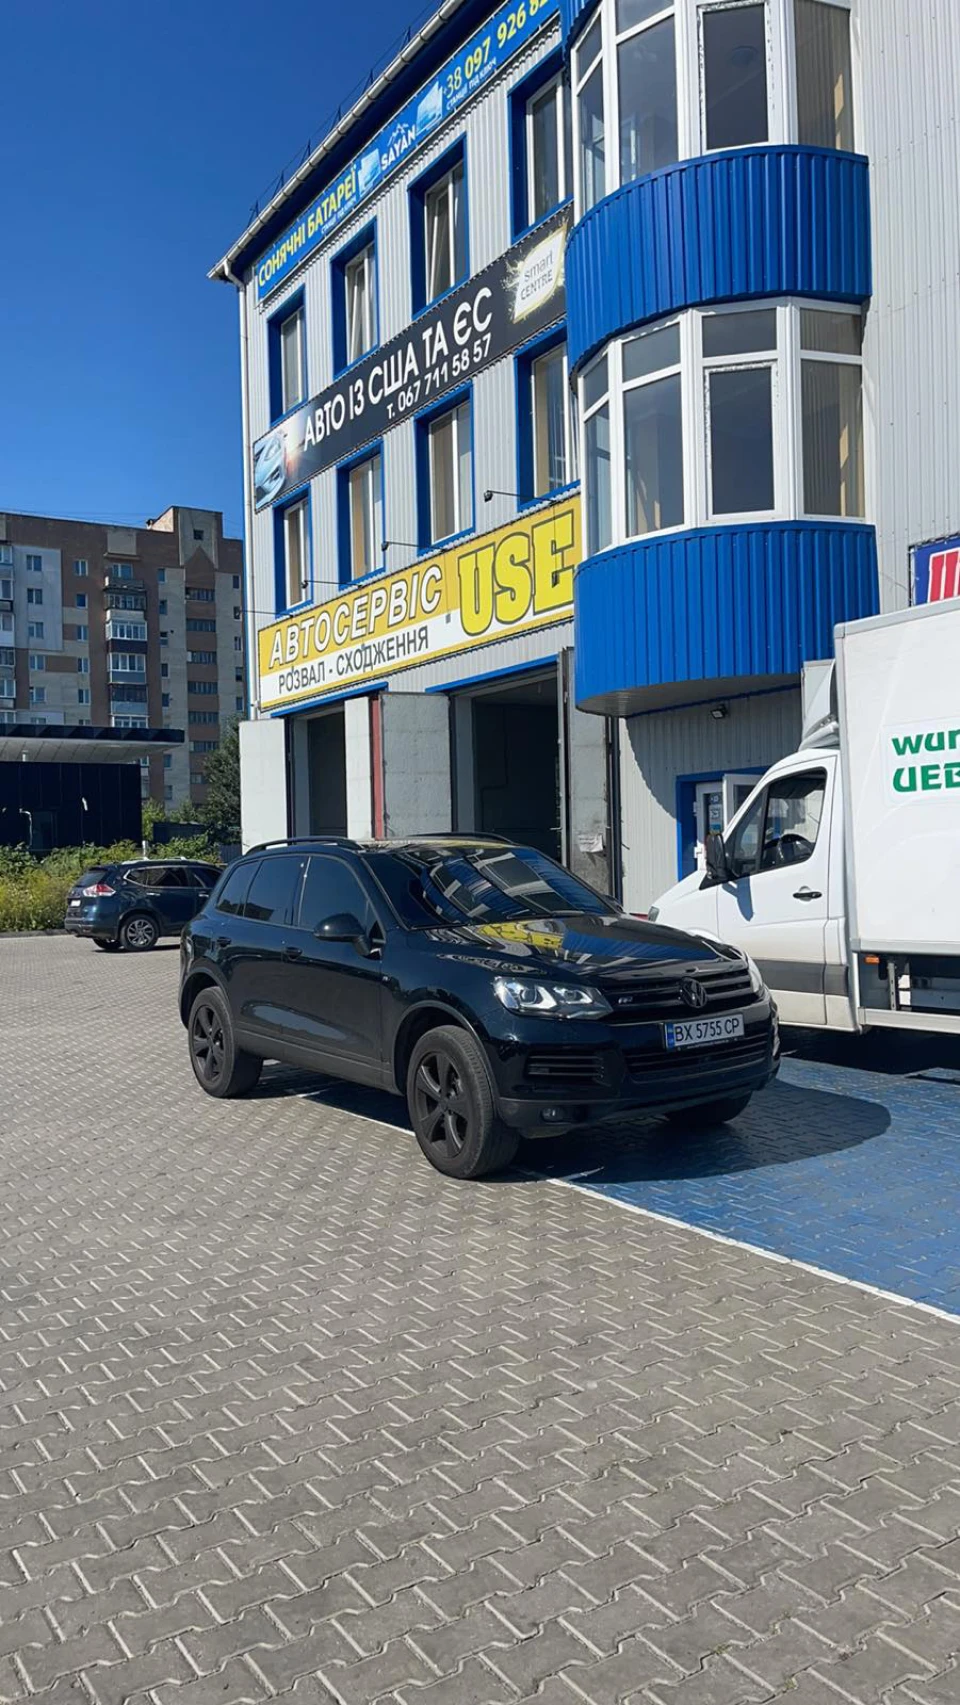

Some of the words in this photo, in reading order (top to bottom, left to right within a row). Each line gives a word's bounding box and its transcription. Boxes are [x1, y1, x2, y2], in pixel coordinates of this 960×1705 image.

[465, 36, 491, 79] 097
[497, 2, 526, 48] 926
[381, 125, 416, 171] SAYAN
[258, 222, 305, 286] СОНЯЧНІ
[307, 164, 357, 238] БАТАРЕЇ
[521, 269, 553, 300] CENTRE
[524, 250, 553, 282] smart
[304, 394, 345, 451] АВТО
[350, 379, 365, 420] ІЗ
[368, 342, 418, 405] США
[422, 321, 448, 365] ТА
[453, 287, 492, 346] ЄС
[398, 381, 420, 412] 067
[424, 362, 448, 395] 711
[452, 348, 470, 377] 58
[473, 333, 491, 363] 57
[457, 508, 574, 636] USE
[268, 564, 443, 669] АВТОСЕРВІС
[278, 660, 326, 694] РОЗВАЛ
[336, 626, 429, 674] СХОДЖЕННЯ
[675, 1026, 693, 1042] BX
[697, 1020, 722, 1039] 5755
[724, 1018, 740, 1035] CP
